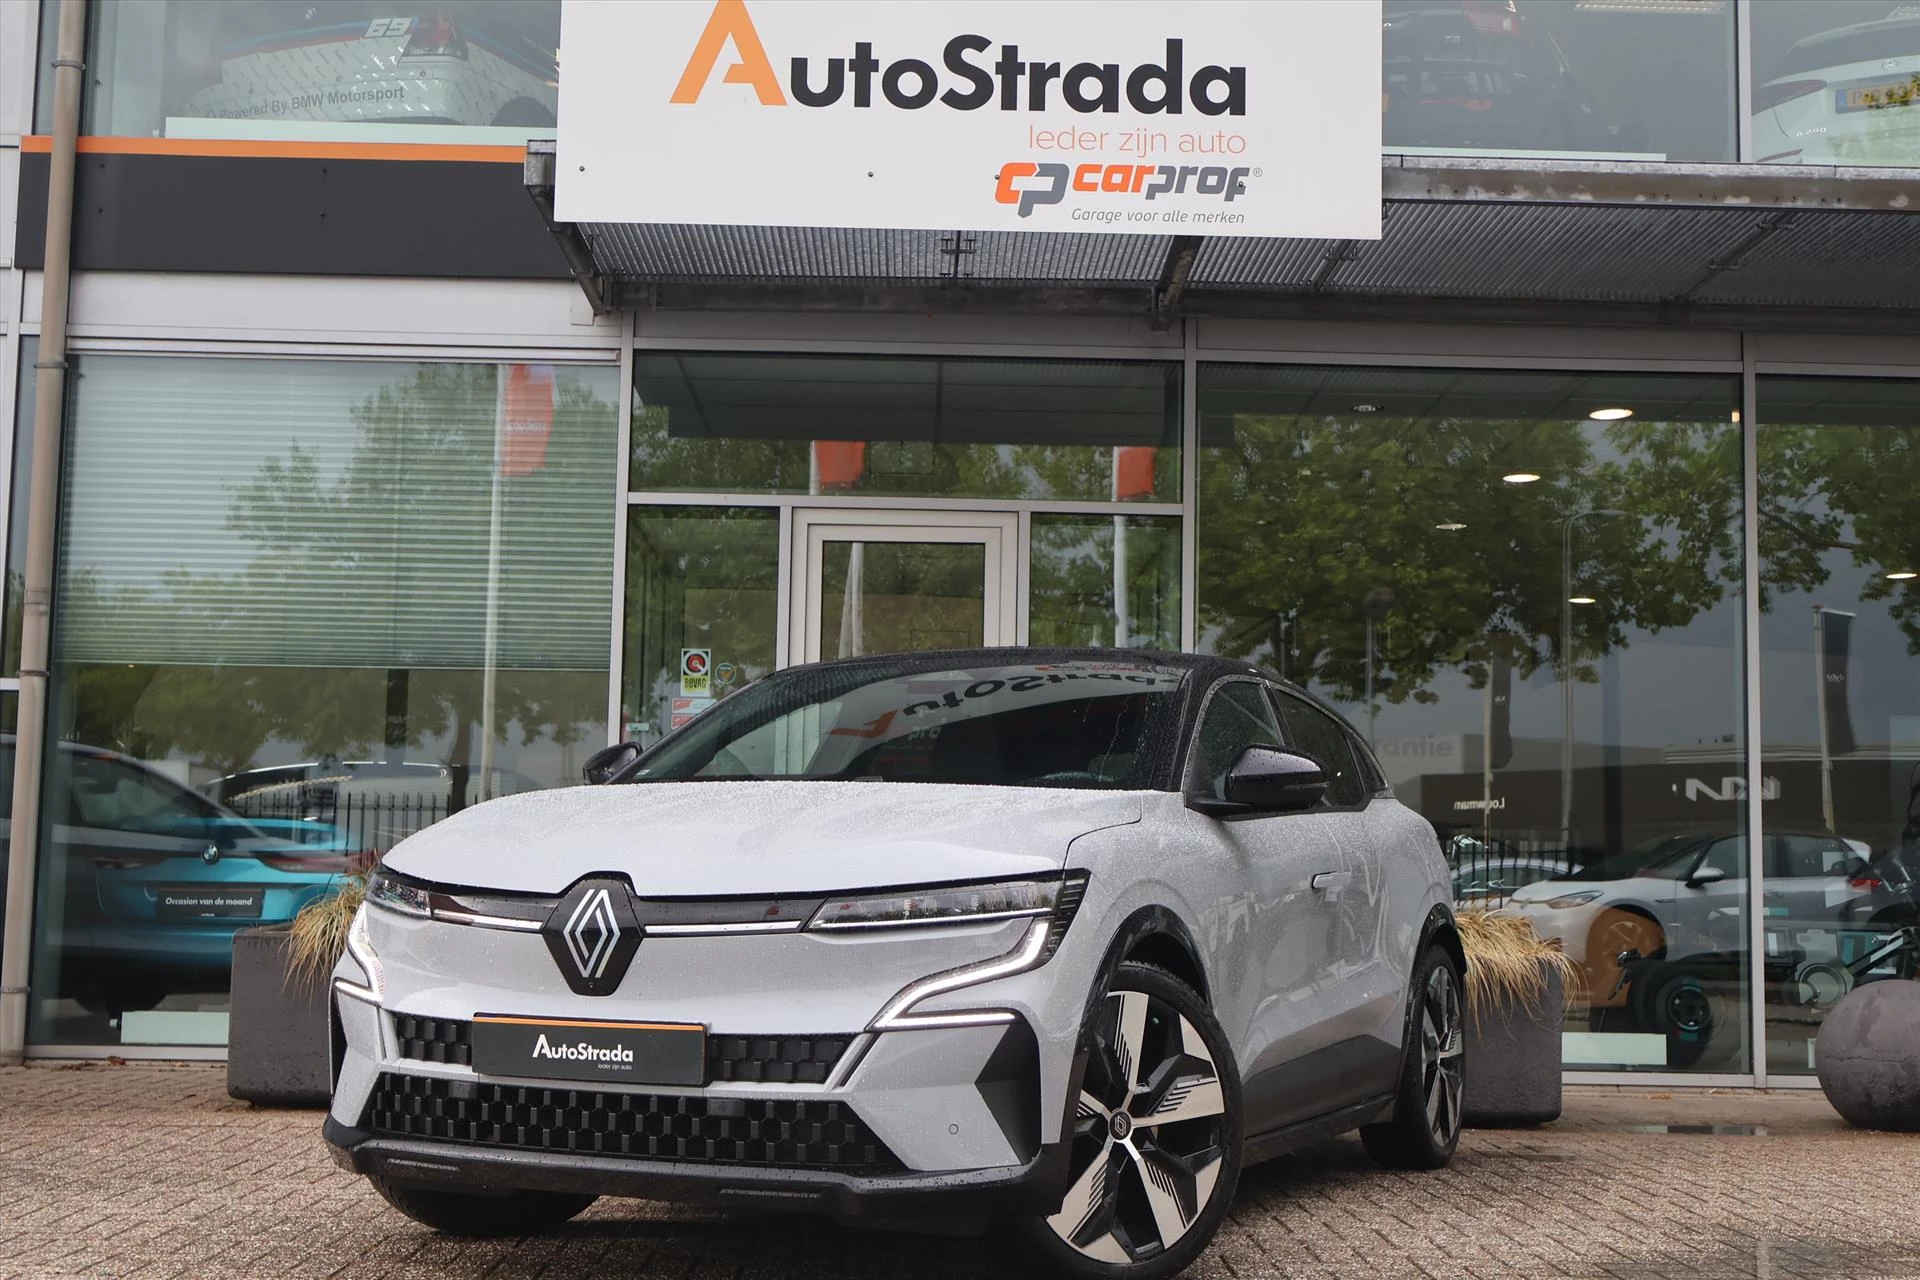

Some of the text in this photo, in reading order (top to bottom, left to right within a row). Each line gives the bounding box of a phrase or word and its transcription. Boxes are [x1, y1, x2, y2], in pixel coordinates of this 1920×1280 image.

[365, 17, 413, 38] 69
[669, 0, 1246, 116] AutoStrada
[220, 99, 268, 119] Powered
[272, 100, 290, 114] By
[292, 95, 325, 111] BMW
[328, 87, 405, 106] Motorsport
[1029, 125, 1246, 158] Ieder zijn auto
[1071, 208, 1245, 224] Garage voor alle merken
[165, 897, 253, 906] Occasion van de maand
[532, 1034, 634, 1062] AutoStrada
